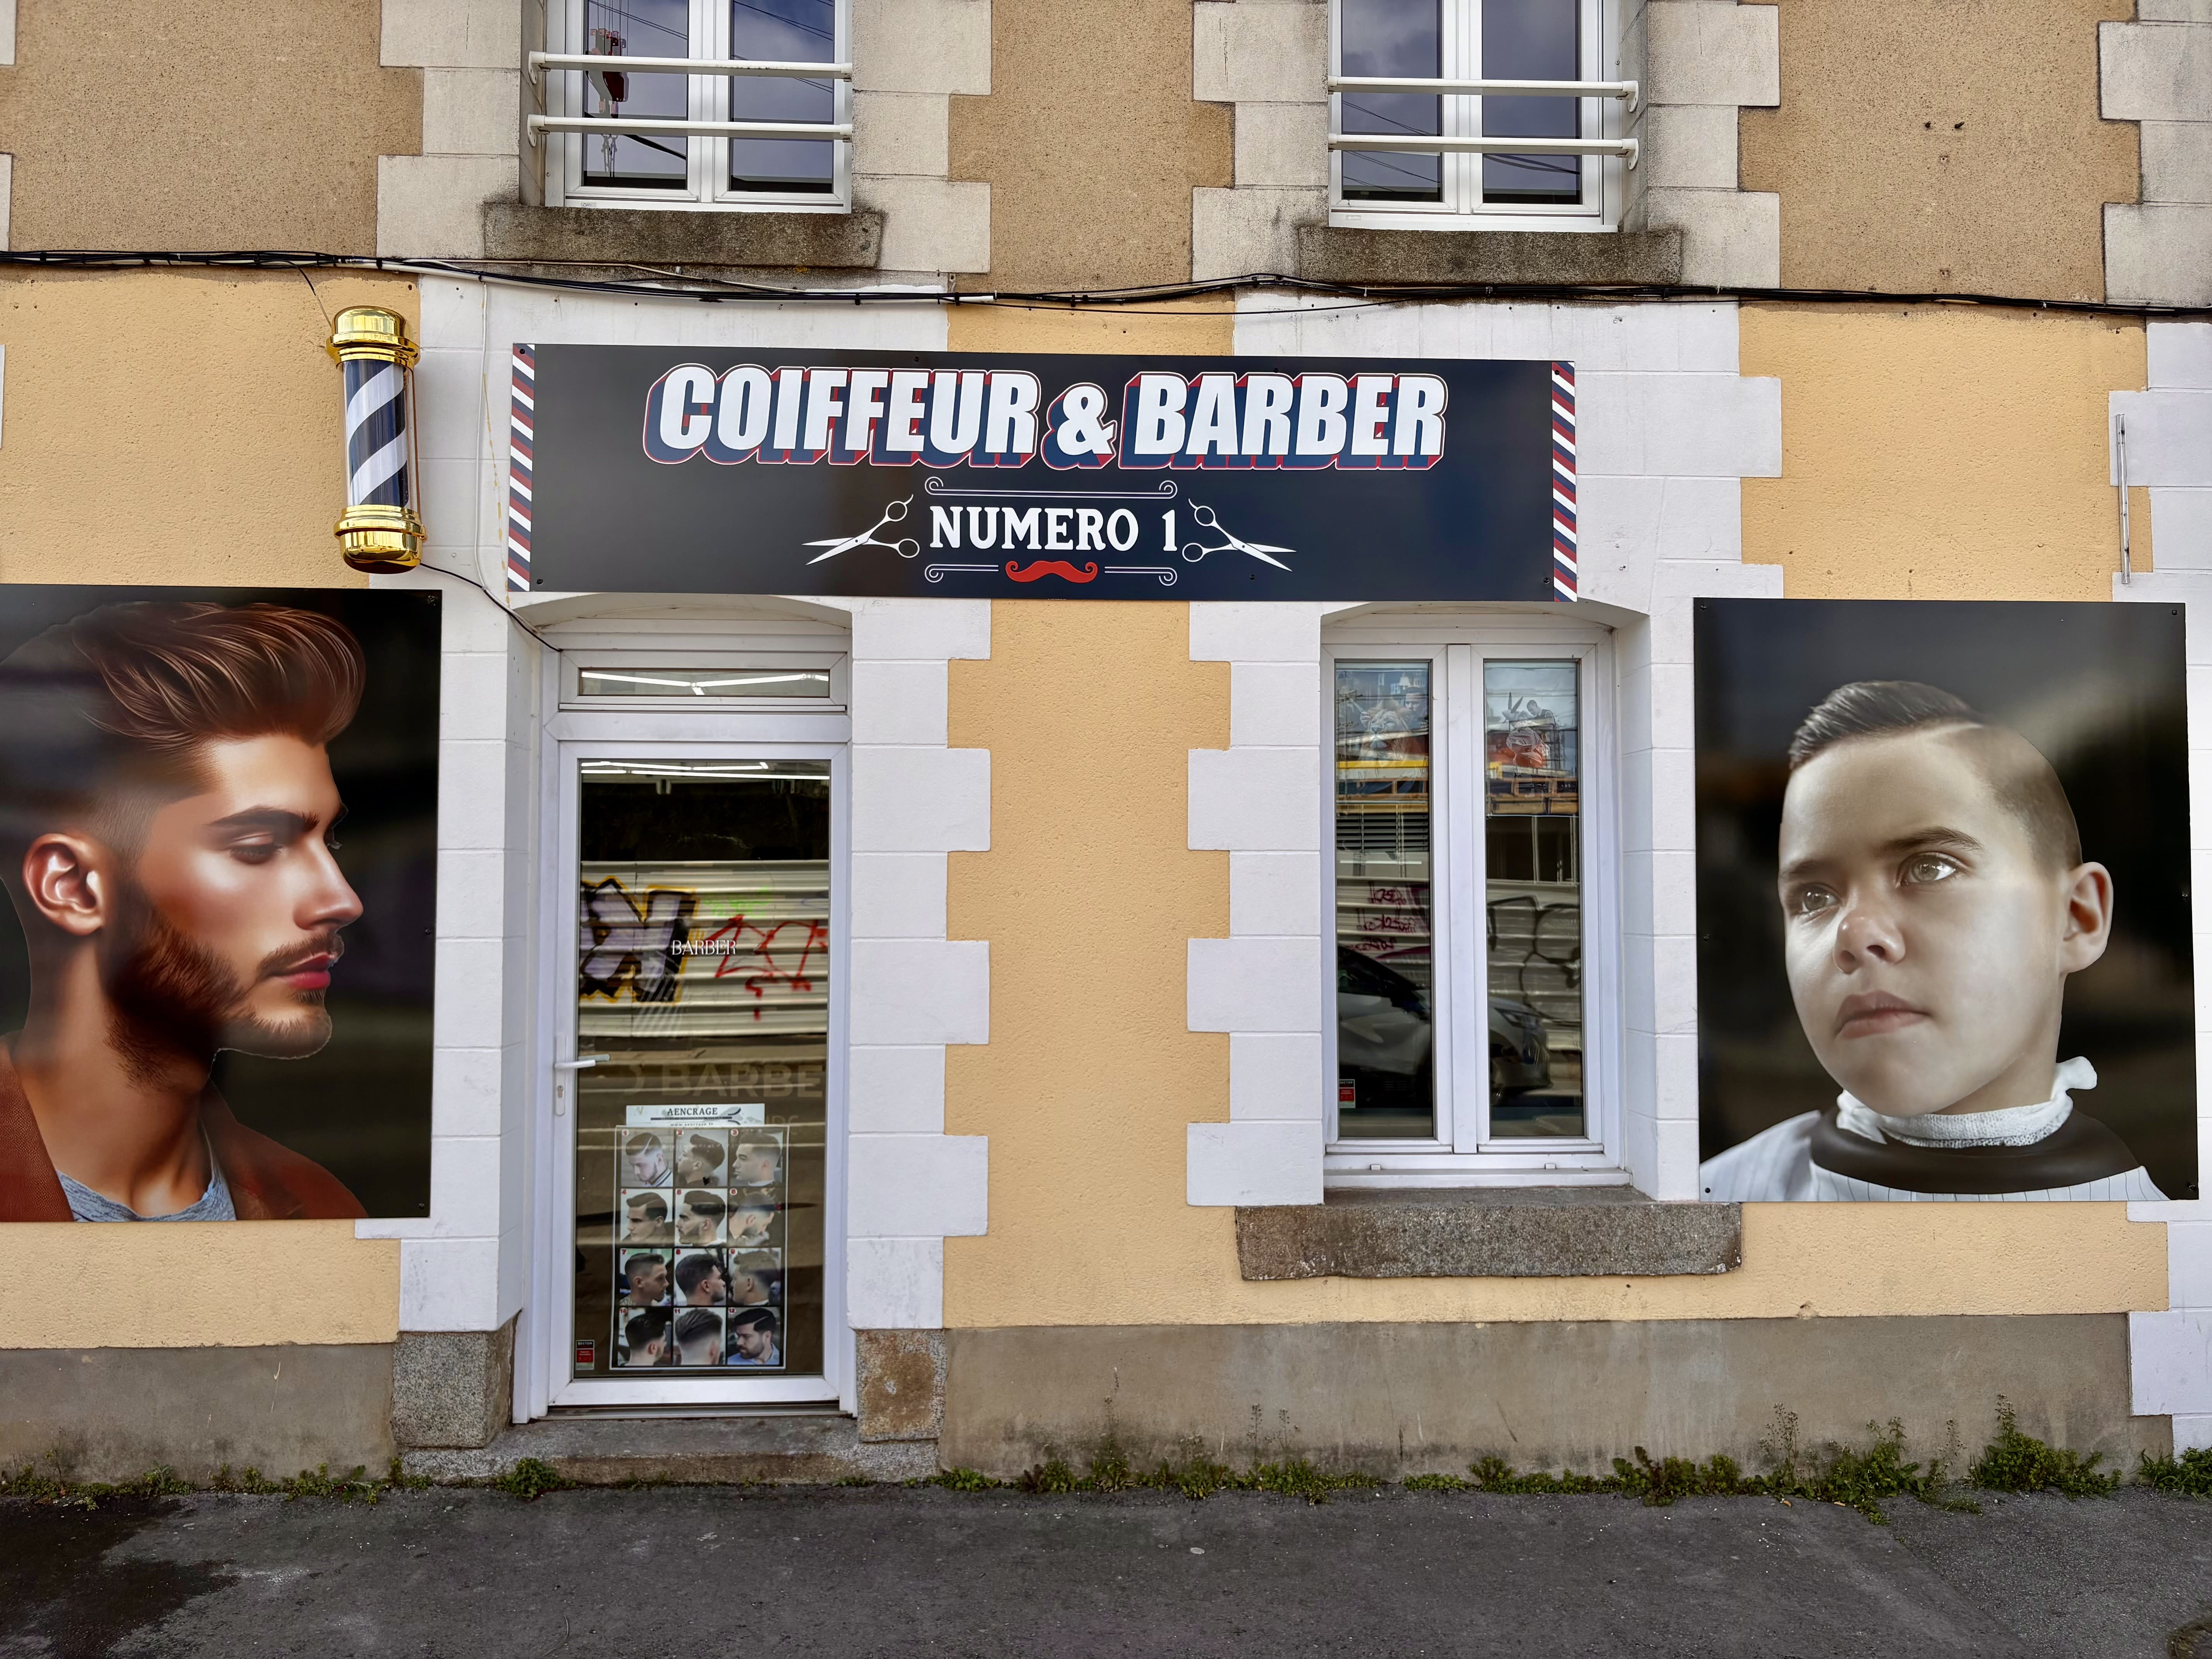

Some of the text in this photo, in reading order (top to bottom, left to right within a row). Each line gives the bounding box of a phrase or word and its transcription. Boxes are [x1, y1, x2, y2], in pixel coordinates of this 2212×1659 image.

[647, 365, 1447, 466] COIFFEUR & BARBER
[930, 506, 1177, 551] NUMERO 1
[672, 939, 736, 955] BARBER
[668, 1108, 718, 1116] AENCRAGE
